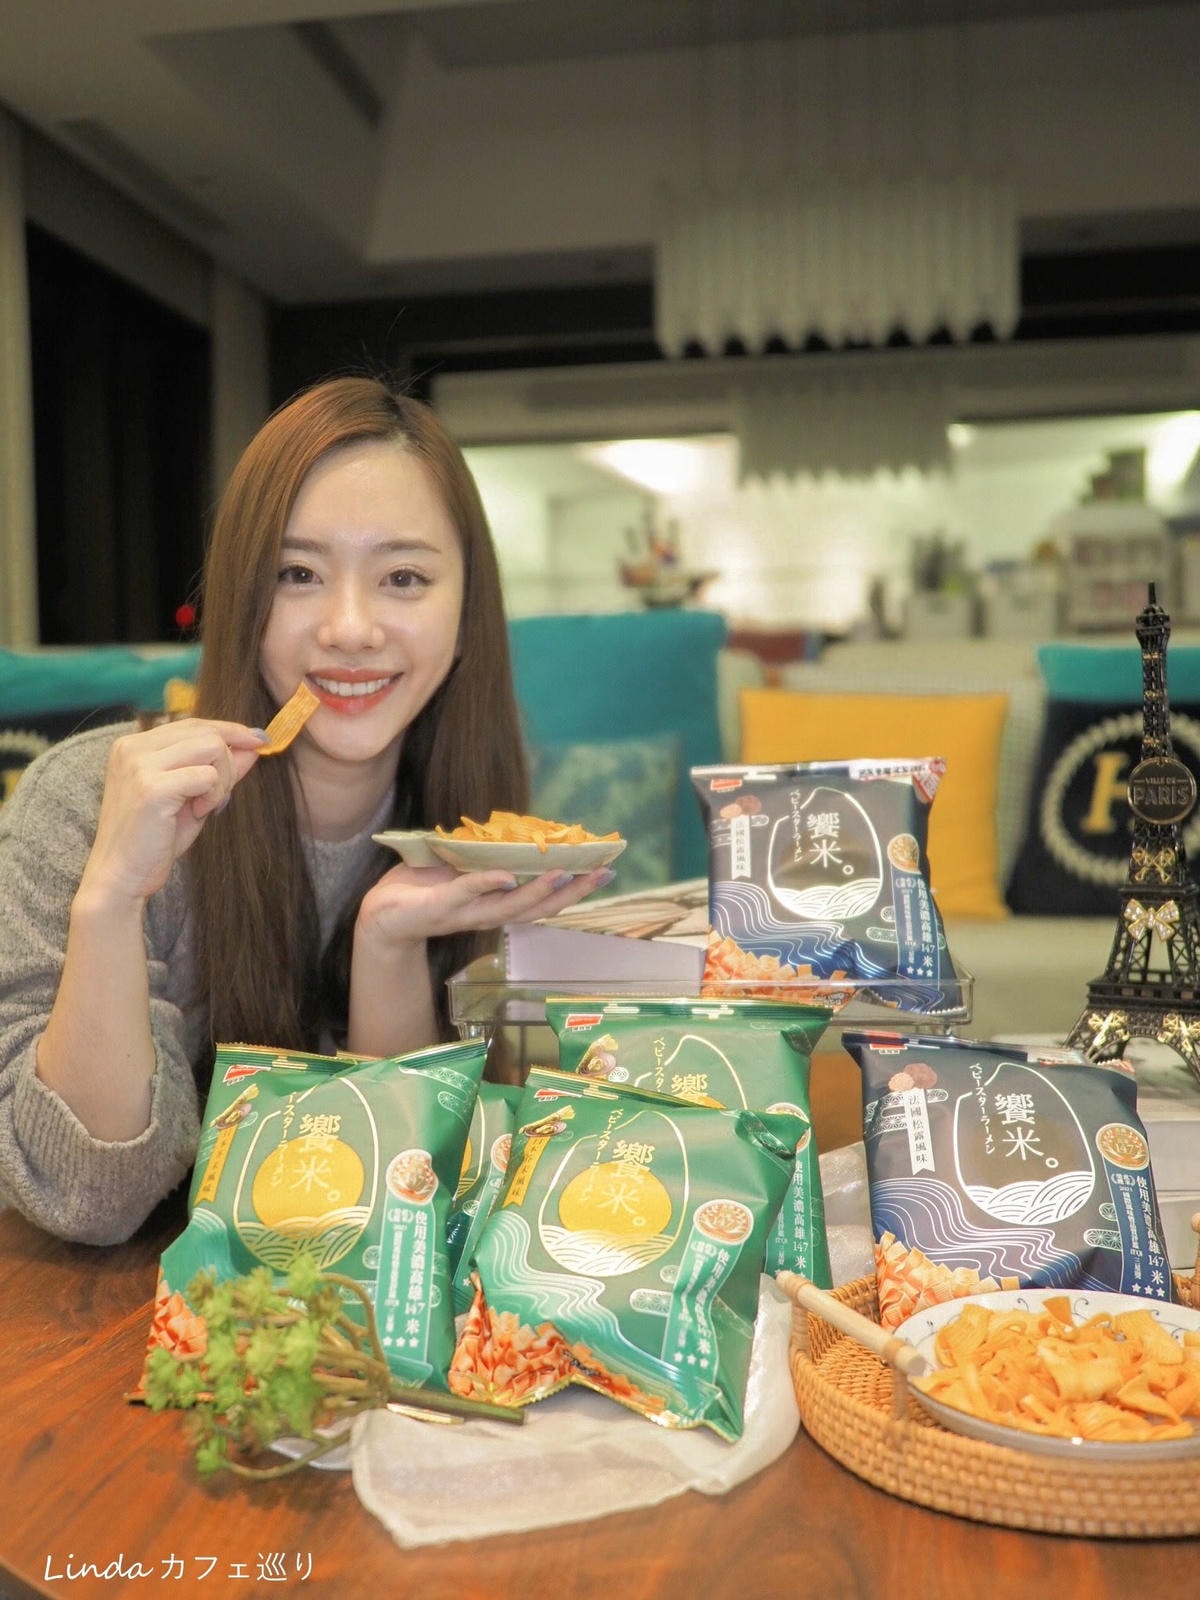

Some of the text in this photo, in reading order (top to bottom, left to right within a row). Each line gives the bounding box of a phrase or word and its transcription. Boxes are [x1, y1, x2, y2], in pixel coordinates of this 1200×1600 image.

[1133, 785, 1189, 806] PARIS
[653, 1036, 666, 1093] ベビースタ
[271, 1091, 298, 1186] ースターラーメン
[968, 1063, 996, 1155] ベビースターラーメン
